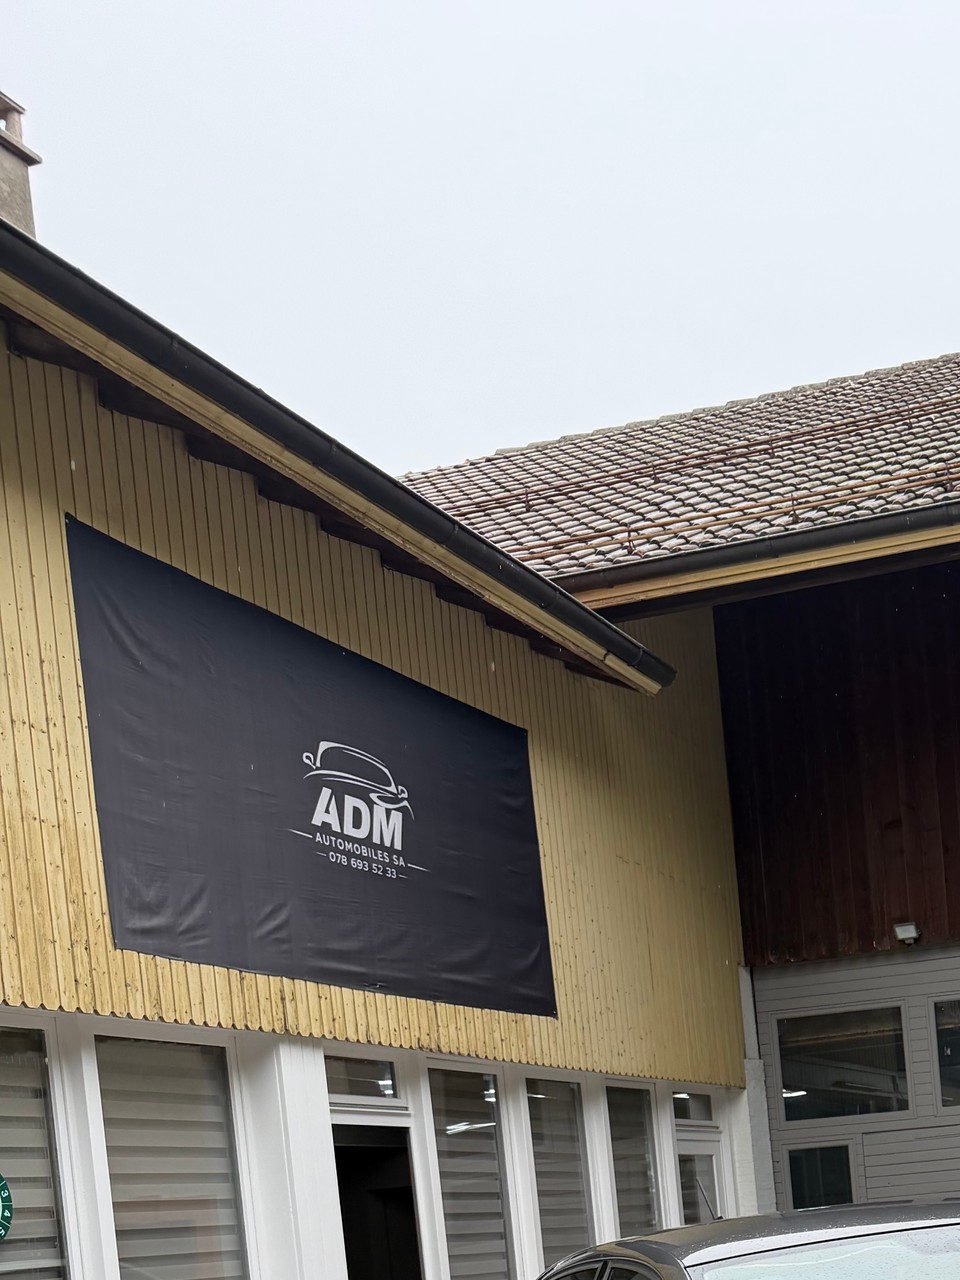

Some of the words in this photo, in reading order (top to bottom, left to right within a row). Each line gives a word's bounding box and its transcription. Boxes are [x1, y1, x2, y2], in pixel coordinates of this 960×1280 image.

[311, 786, 403, 851] ADM
[315, 832, 390, 863] AUTOMOBILES
[393, 857, 406, 868] SA
[328, 851, 348, 866] 078
[350, 857, 369, 872] 693
[372, 863, 384, 876] 52
[385, 867, 397, 879] 33
